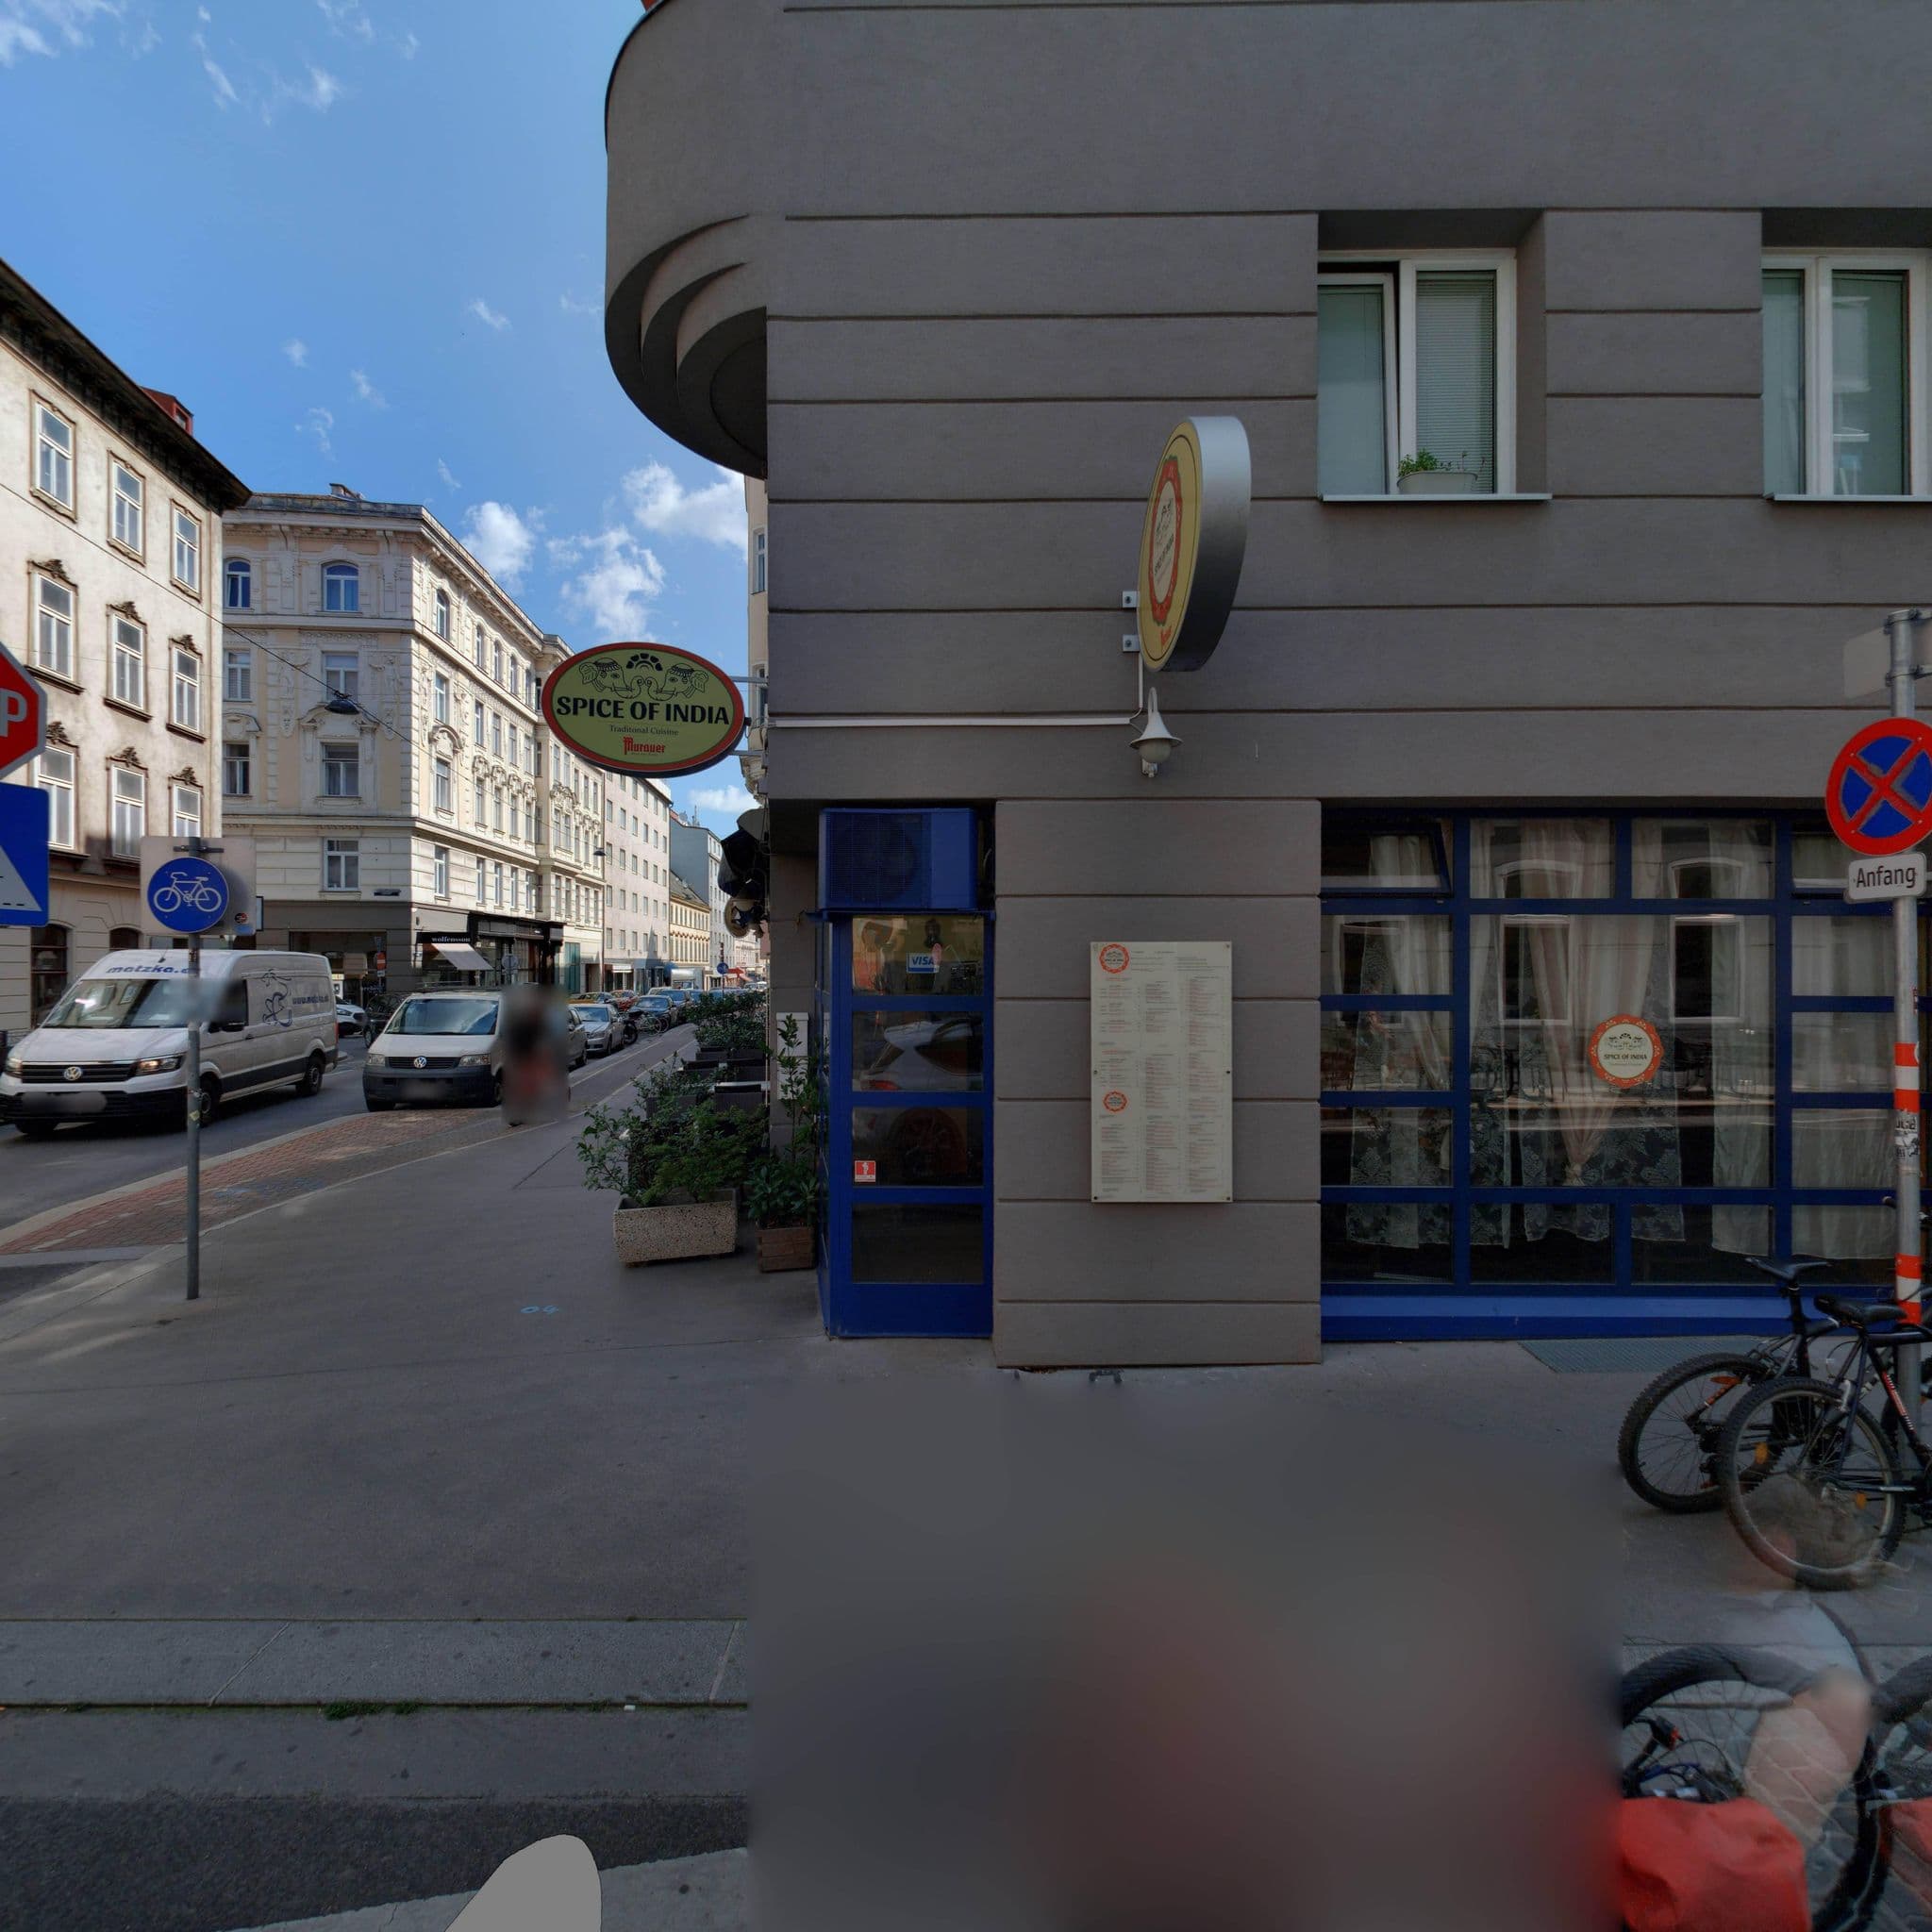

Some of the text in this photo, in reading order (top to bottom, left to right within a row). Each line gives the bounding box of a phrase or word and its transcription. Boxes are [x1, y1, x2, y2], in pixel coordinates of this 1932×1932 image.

[557, 696, 730, 725] SPICE OF INDIA
[623, 736, 666, 755] Murauer
[1856, 865, 1917, 889] Anfang
[911, 956, 935, 966] VISA
